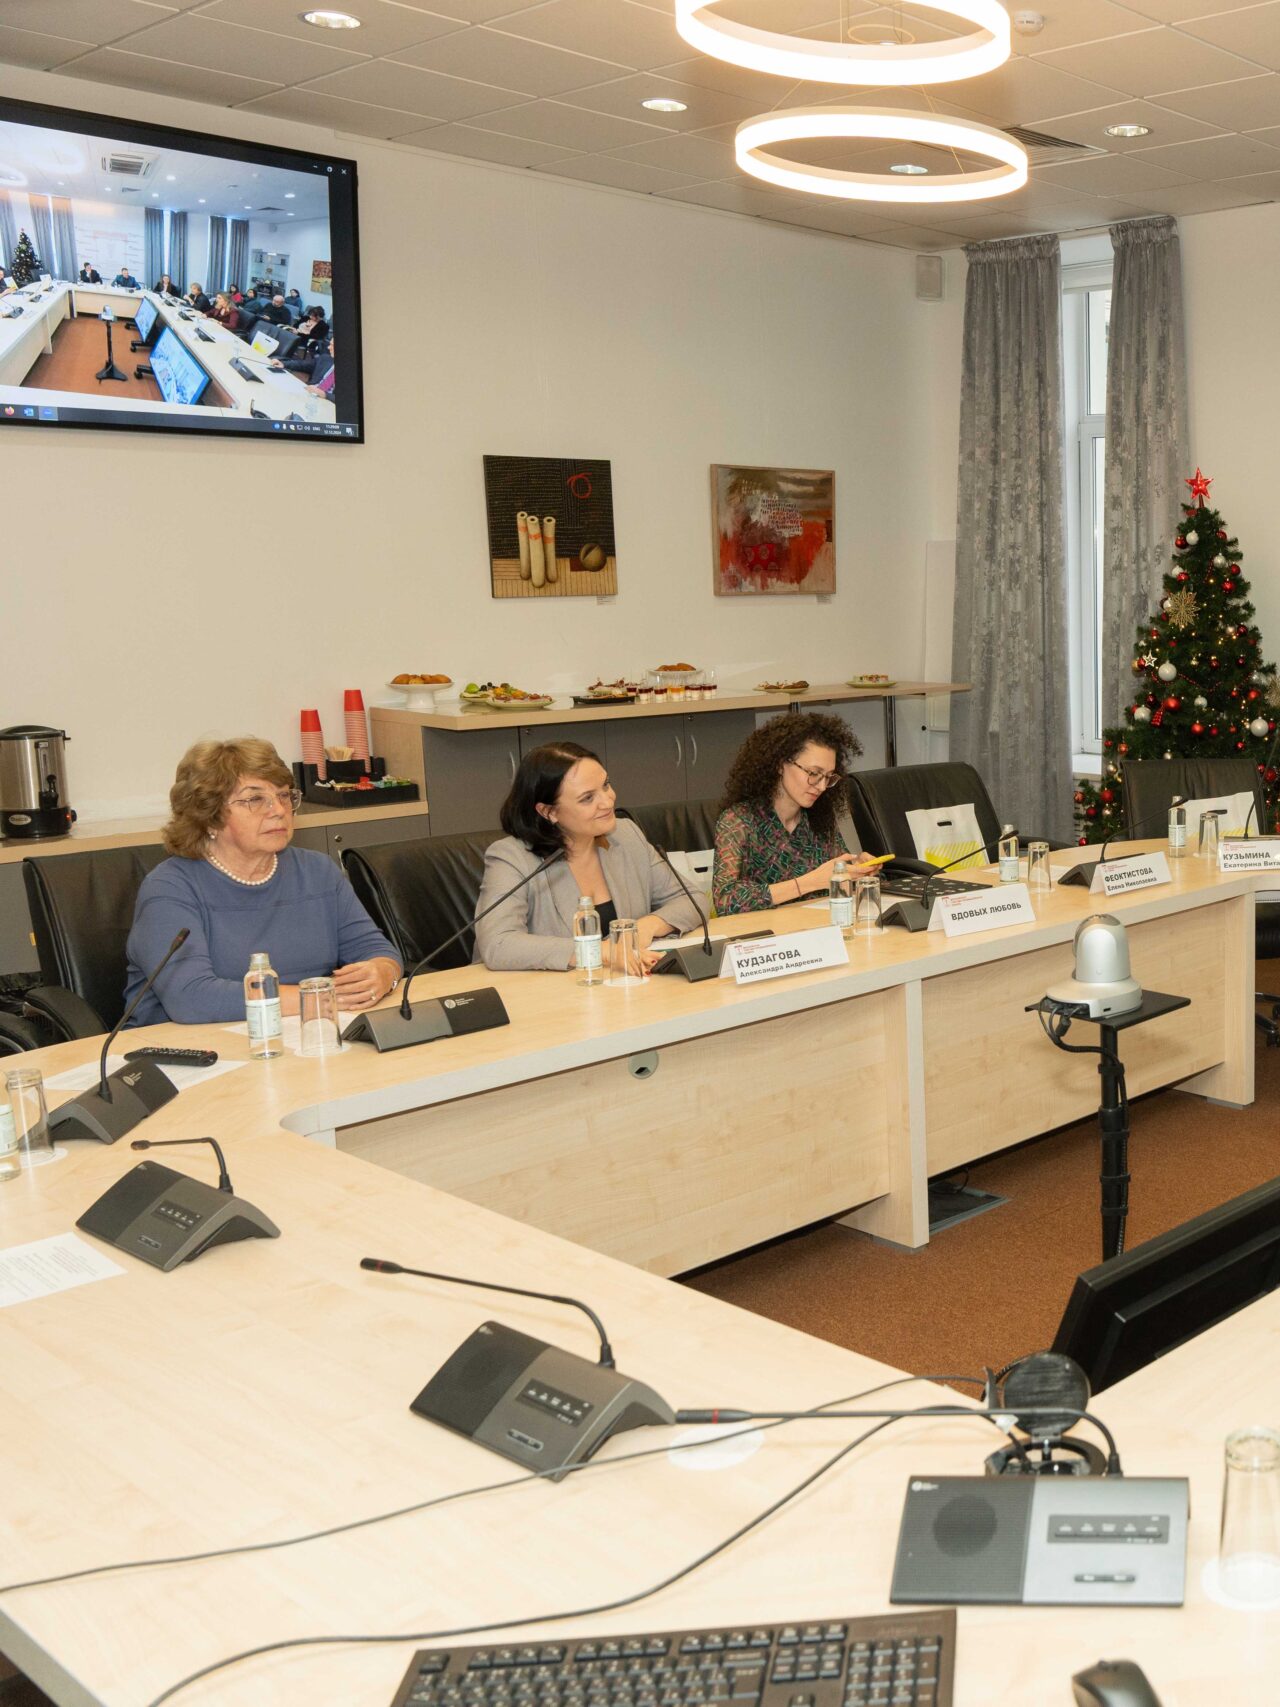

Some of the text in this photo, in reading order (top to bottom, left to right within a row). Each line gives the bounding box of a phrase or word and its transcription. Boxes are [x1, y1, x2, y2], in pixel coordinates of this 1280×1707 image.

[1223, 852, 1271, 860] КУЗЬМИНА
[1104, 867, 1153, 882] ФЕОКТИСТОВА
[951, 902, 1022, 921] ВДОВЫХ ЛЮБОВЬ
[736, 949, 801, 968] КУДЗАГОВА
[740, 957, 823, 978] Александра Андреевна
